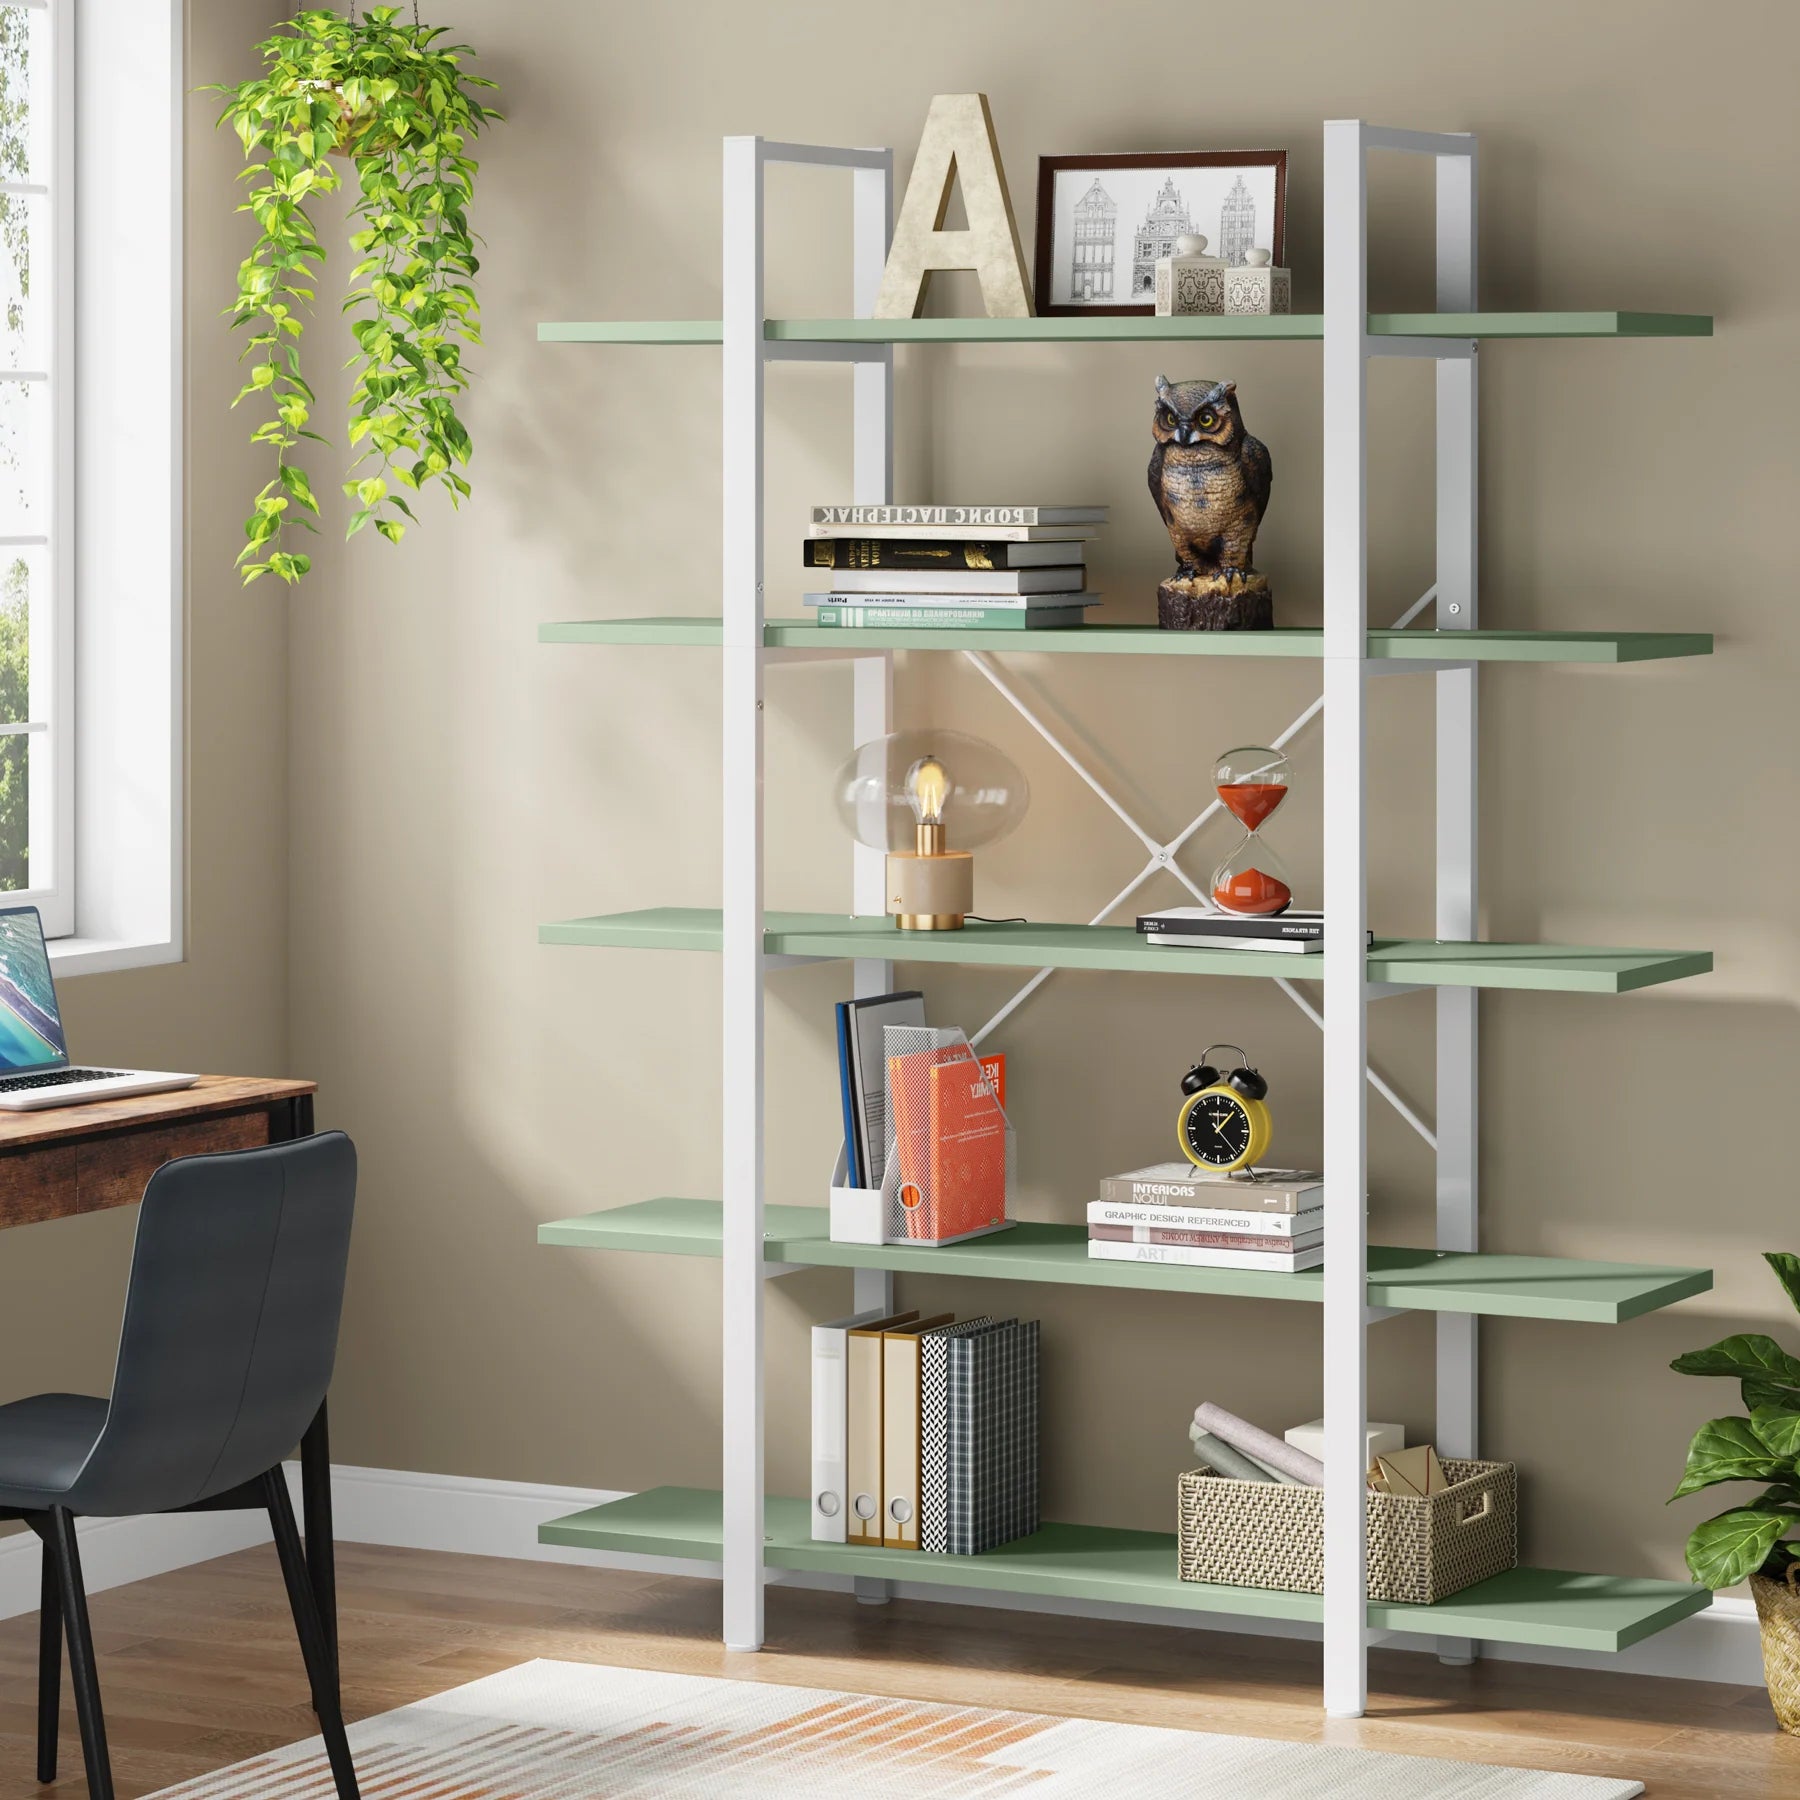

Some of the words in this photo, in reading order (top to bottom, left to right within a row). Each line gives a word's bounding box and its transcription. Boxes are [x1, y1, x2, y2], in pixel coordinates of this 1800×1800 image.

[873, 93, 1037, 319] A
[820, 508, 947, 524] ПАСТЕРНАК
[954, 508, 1025, 524] БОРИС
[1132, 1183, 1196, 1197] INTERIORS
[1104, 1210, 1147, 1221] GRAPHIC
[1149, 1213, 1185, 1224] DESIGN
[1187, 1216, 1251, 1228] REFERENCED
[1161, 1231, 1189, 1243] LOOMIS
[1189, 1232, 1220, 1244] ANDREW
[1220, 1233, 1230, 1245] by
[1264, 1238, 1290, 1249] Creative
[1135, 1246, 1168, 1262] ART
